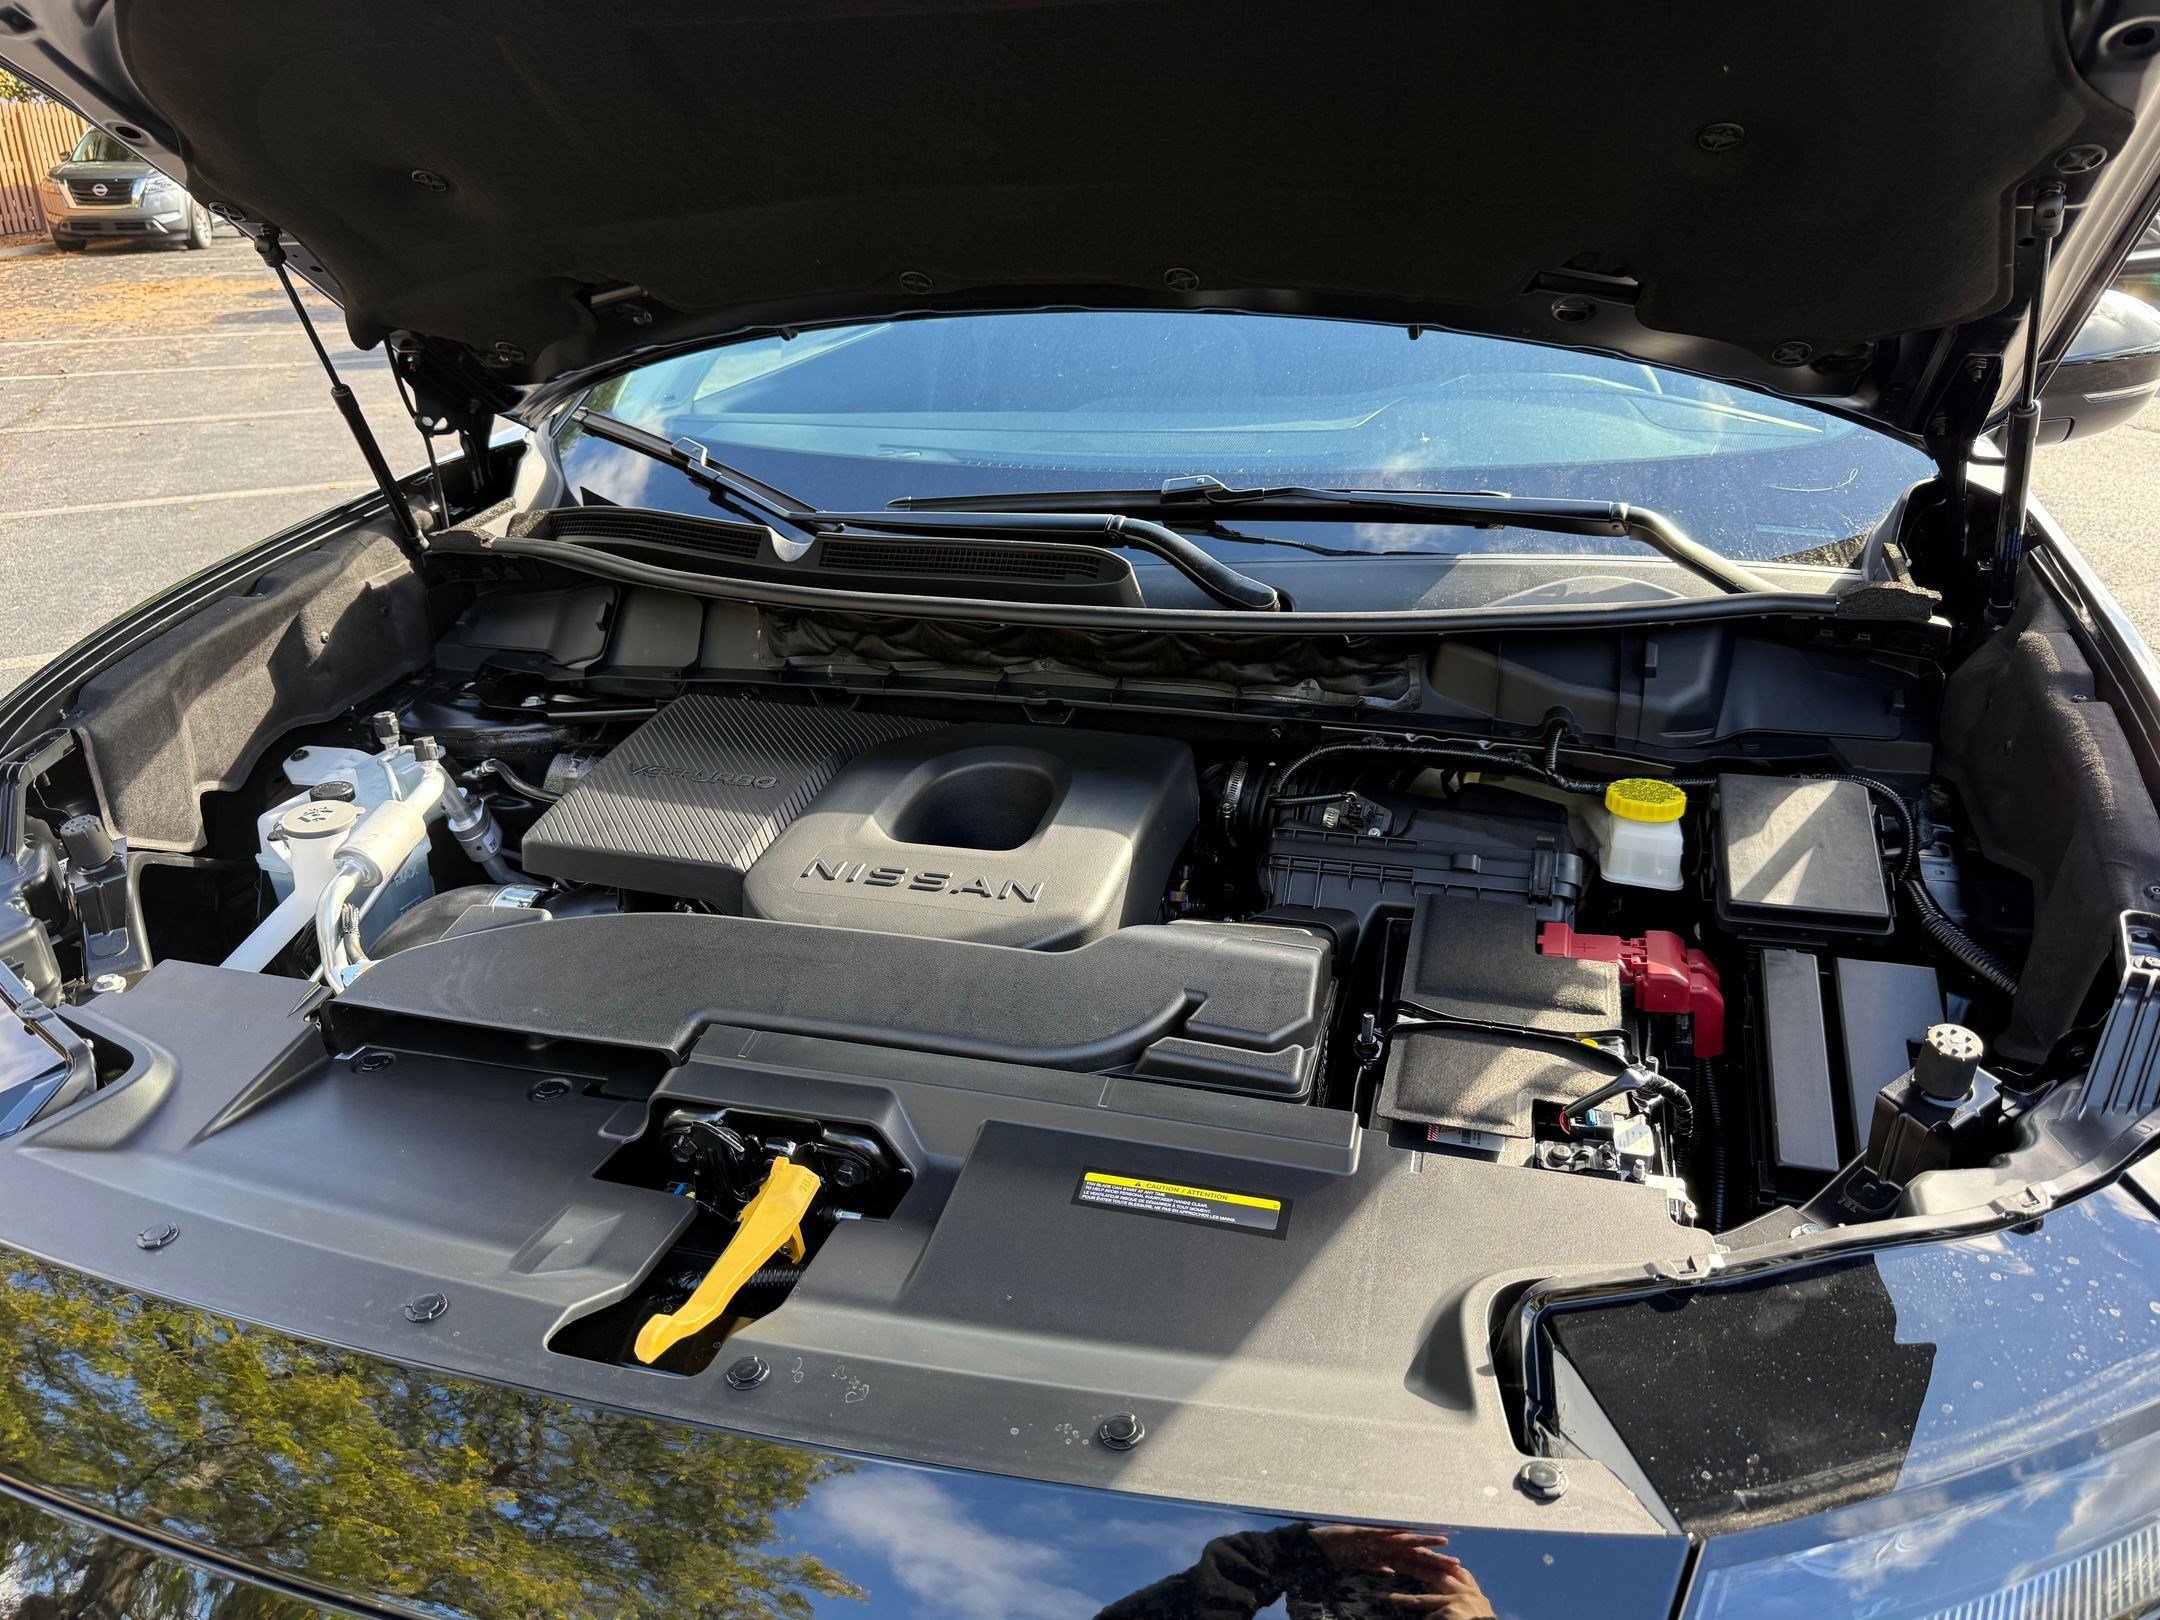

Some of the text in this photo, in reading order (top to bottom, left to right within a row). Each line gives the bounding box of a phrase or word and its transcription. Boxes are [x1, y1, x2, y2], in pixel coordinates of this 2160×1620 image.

[800, 857, 1046, 904] NISSAN
[1146, 1183, 1179, 1193] CAUTION
[1187, 1189, 1229, 1200] ATTENTION
